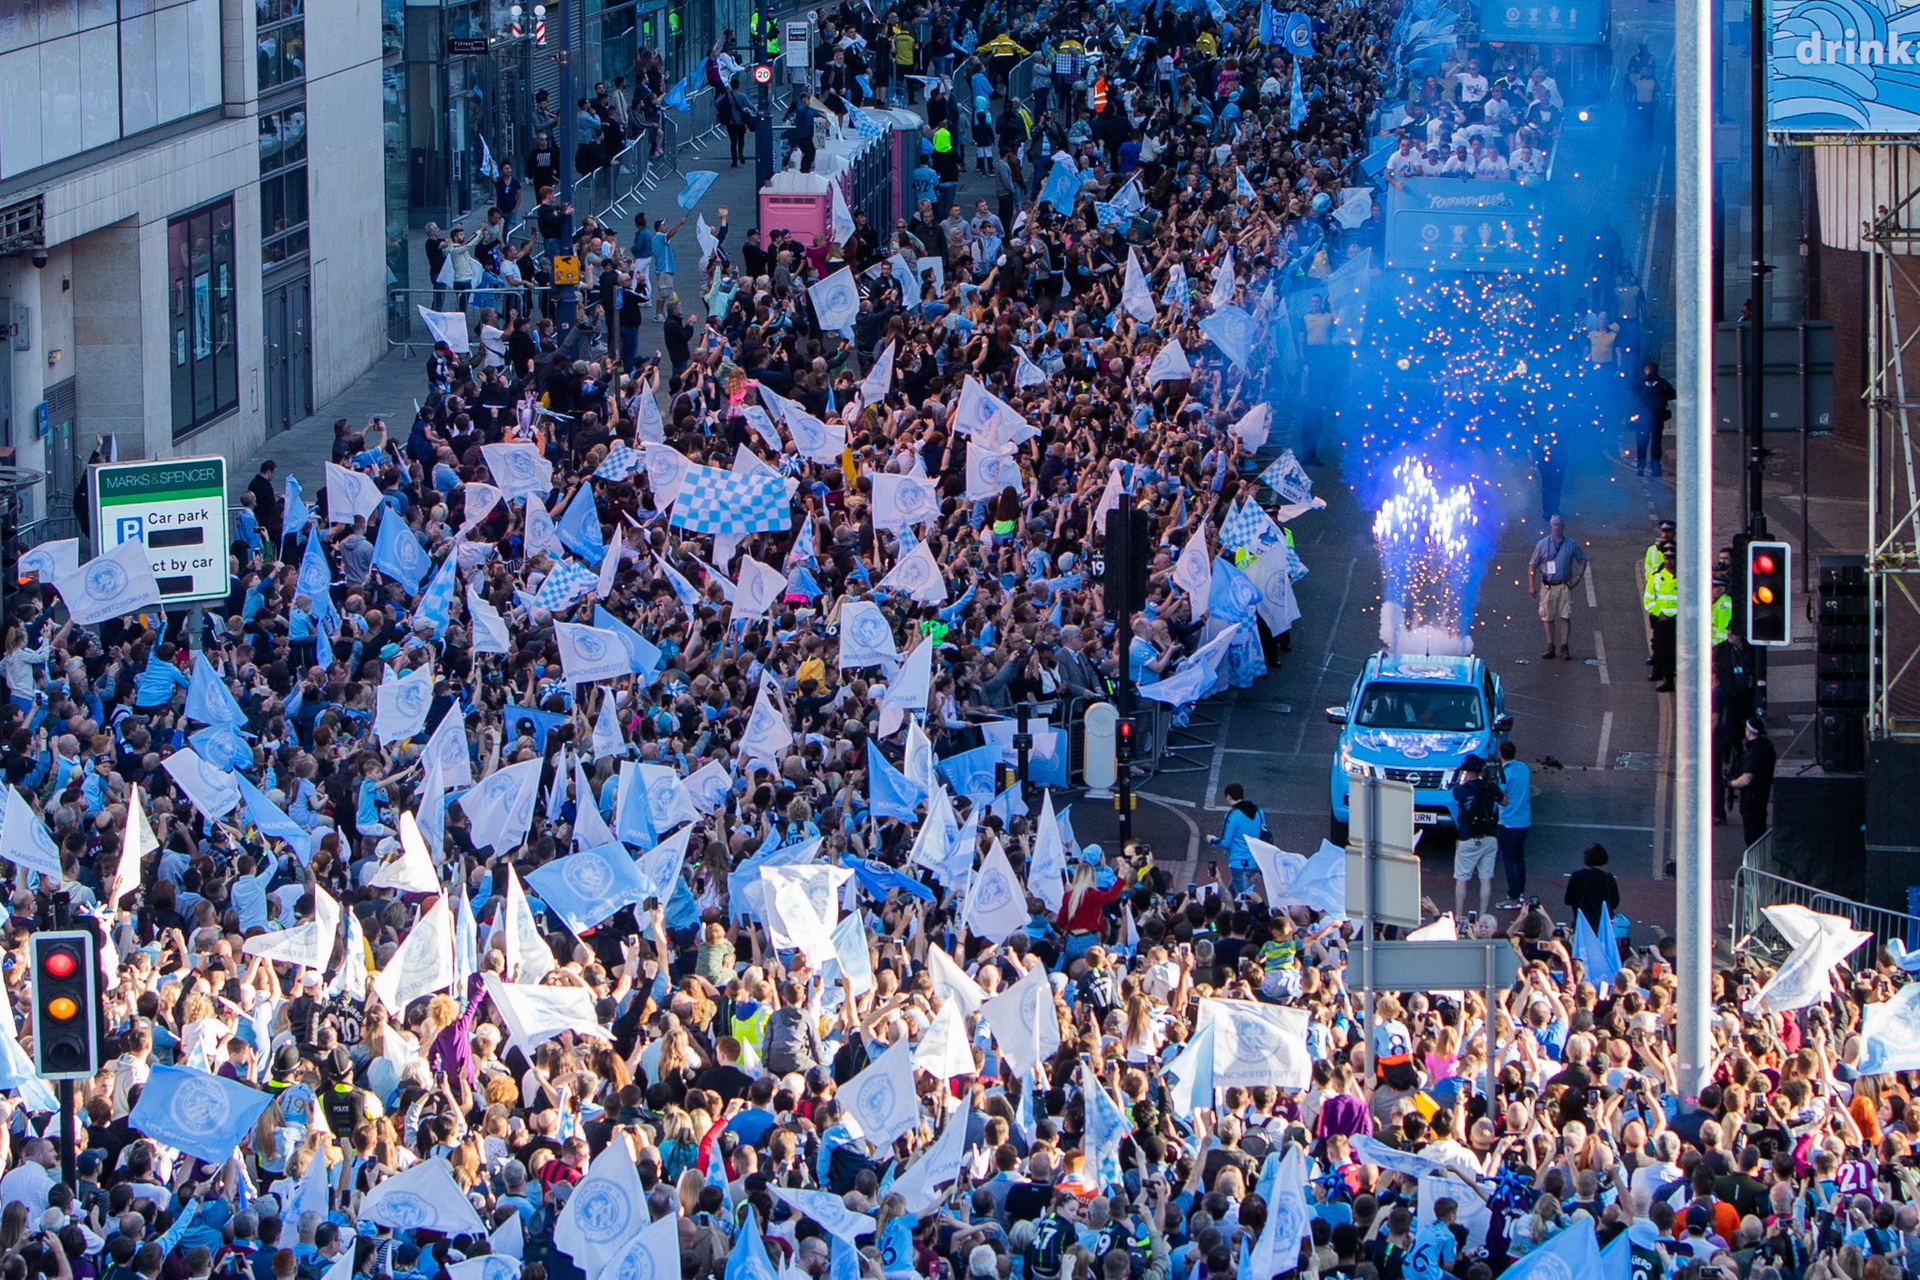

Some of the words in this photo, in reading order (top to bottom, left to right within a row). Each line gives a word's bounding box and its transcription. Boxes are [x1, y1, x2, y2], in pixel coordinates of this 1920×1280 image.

[1796, 28, 1920, 65] drink
[757, 71, 769, 79] 20
[148, 512, 172, 525] Car
[178, 509, 209, 524] park
[122, 520, 140, 540] P
[171, 559, 188, 574] by
[191, 557, 214, 569] car
[1091, 561, 1104, 575] 19
[1414, 813, 1432, 822] URN
[338, 1017, 361, 1043] 10
[1389, 1034, 1406, 1055] 8
[1213, 1070, 1272, 1080] ANCHESTER
[285, 1095, 305, 1114] 19
[1837, 1162, 1868, 1192] 21
[1632, 1255, 1653, 1270] ÜERO
